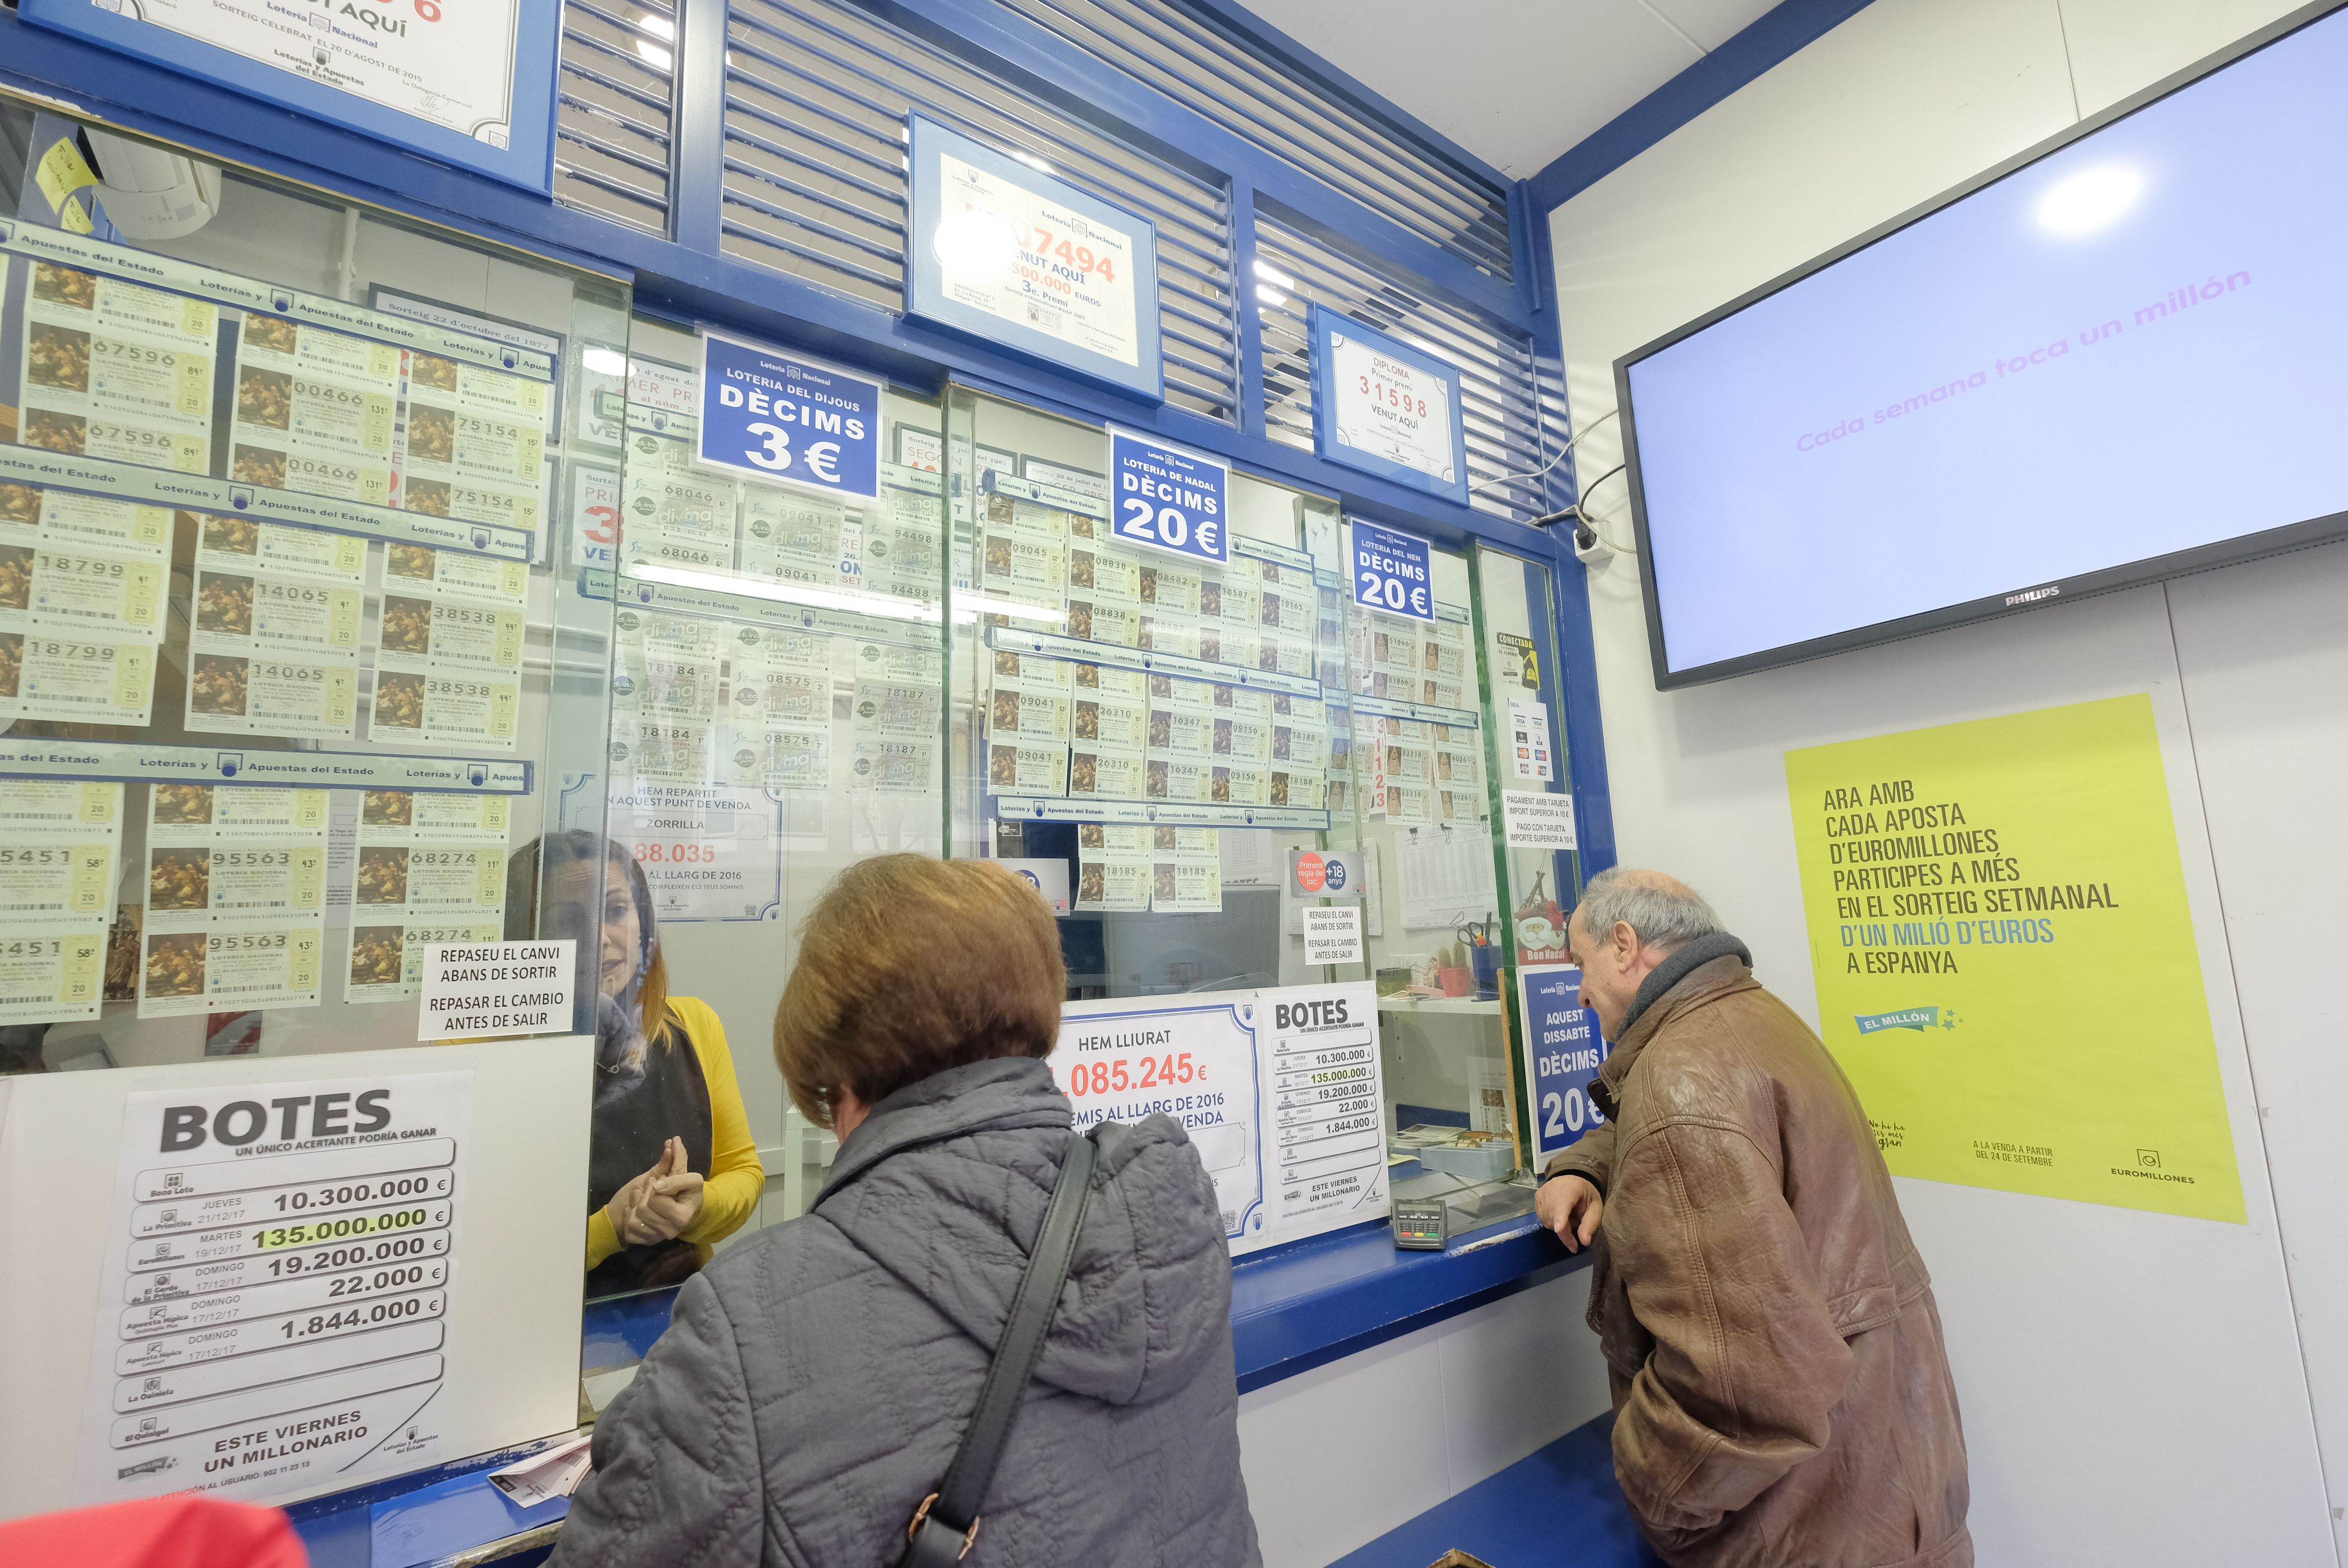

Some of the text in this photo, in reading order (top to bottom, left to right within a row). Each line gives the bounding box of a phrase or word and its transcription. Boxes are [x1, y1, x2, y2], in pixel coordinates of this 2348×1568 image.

[339, 2, 406, 38] AQUÍ
[21, 235, 164, 276] Apuestas del Estado
[1075, 292, 1101, 307] EUROS
[388, 302, 550, 350] Sorteig 22 d'octubre del 1977
[93, 339, 176, 367] 67596
[1797, 269, 2252, 452] Cada semana toca un millón
[1372, 368, 1413, 392] Primer premi
[1373, 358, 1409, 380] DIPLOMA
[294, 381, 364, 406] 00466
[727, 367, 859, 412] LOTERIA DEL DIJOUS
[720, 384, 865, 440] DÈCIMS
[1371, 404, 1418, 430] VENUT AQUÍ
[744, 422, 841, 483] 3 €
[1124, 457, 1216, 492] LOTERIA DE NADAL
[665, 484, 712, 502] 68046
[1123, 472, 1217, 514] DÈCIMS
[1123, 498, 1218, 555] 20 €
[1362, 540, 1420, 562] LOTERIA DEL NEN
[1360, 551, 1425, 581] DÈCIMS
[258, 584, 329, 602] 14065
[1361, 572, 1428, 615] 20 €
[2005, 586, 2059, 606] PHILIPS
[433, 606, 496, 625] 38538
[1499, 635, 1533, 649] CONECTADA
[1020, 695, 1054, 708] 09041
[1100, 706, 1131, 719] 26310
[1173, 716, 1201, 728] 16347
[637, 787, 717, 798] HEM REPARTIT
[1507, 796, 1535, 804] PAGAMENT
[1824, 780, 1914, 811] ARA AMB
[646, 819, 704, 829] ZORRILLA
[1826, 802, 1966, 838] CADA APOSTA
[411, 852, 477, 865] 68274
[1829, 829, 2000, 865] D'EUROMILLONES
[212, 852, 291, 867] 95563
[1326, 865, 1343, 878] +18
[1834, 852, 2020, 891] PARTICIPES A MÉS
[1837, 883, 2119, 919] EN EL SORTEIG SETMANAL
[1841, 916, 2054, 947] D'UN MILIÓ D'EUROS
[440, 947, 560, 963] REPASEU EL CANVI
[1527, 948, 1565, 960] Bon Nadal
[1847, 951, 1958, 974] A ESPANYA
[440, 966, 557, 983] ABANS DE SORTIR
[430, 992, 563, 1012] REPASAR EL CAMBIO
[445, 1012, 548, 1031] ANTES DE SALIR
[1275, 999, 1348, 1030] BOTES
[1546, 1009, 1584, 1025] AQUEST
[1863, 1012, 1930, 1030] EL MILLÓN
[1079, 1030, 1171, 1051] HEM LLIURAT
[1543, 1026, 1590, 1044] DISSABTE
[1316, 1049, 1365, 1065] 10.300.000
[1539, 1048, 1599, 1077] DÈCIMS
[1311, 1067, 1366, 1084] 135.000.000
[1318, 1083, 1367, 1100] 19.200.000
[1107, 1092, 1224, 1121] AL LLARG DE 2016
[1338, 1098, 1368, 1113] 22.000
[1542, 1088, 1584, 1138] 20
[159, 1089, 392, 1153] BOTES
[1326, 1117, 1369, 1134] 1.844.000
[235, 1128, 436, 1157] UN ÚNICO ACERTANTE PODRÍA GANAR
[1980, 1141, 1990, 1150] LA
[1991, 1142, 2016, 1152] VENDA
[2026, 1146, 2053, 1156] PARTIR
[1976, 1150, 2053, 1167] DEL 24 DE SETEMBRE
[2110, 1168, 2195, 1184] EUROMILLONES
[274, 1177, 430, 1212] 10.300.000
[251, 1209, 427, 1249] 135.000.000
[267, 1237, 425, 1277] 19.200.000
[328, 1266, 423, 1297] 22.000
[280, 1298, 420, 1340] 1.844.000
[214, 1410, 362, 1453] ESTE VIERNES
[204, 1426, 368, 1474] UN MILLONARIO
